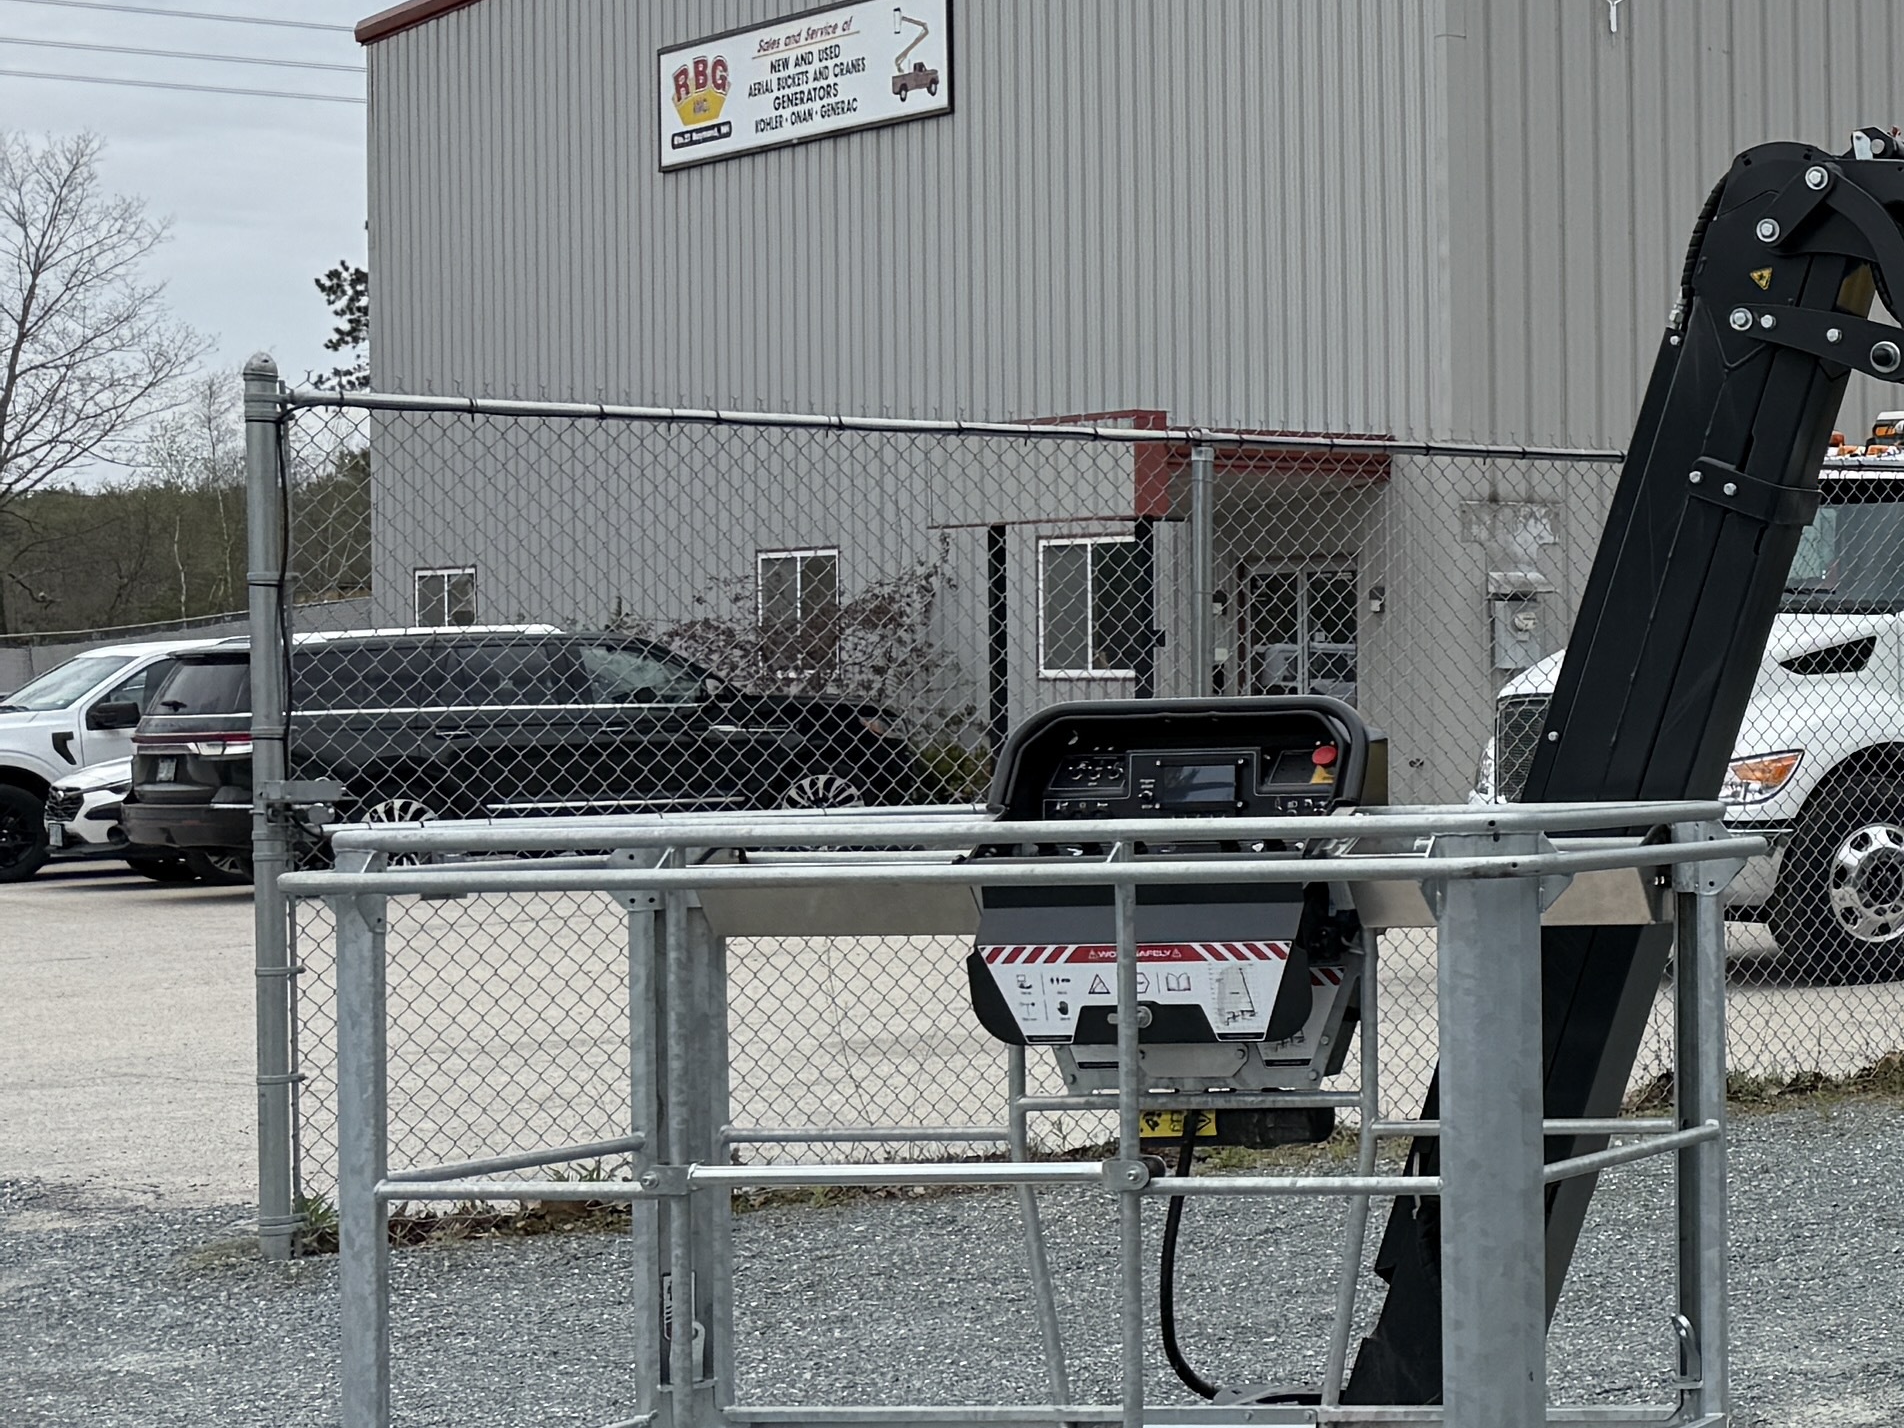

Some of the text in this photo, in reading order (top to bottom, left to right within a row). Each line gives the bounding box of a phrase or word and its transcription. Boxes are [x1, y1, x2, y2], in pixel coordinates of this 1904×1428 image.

[757, 16, 853, 53] Sales and Service of
[770, 44, 840, 74] NEW AND USED
[672, 55, 728, 104] RBG
[748, 57, 866, 98] AERIAL BUCKETS AND CRANES
[773, 83, 839, 111] GENERATORS
[755, 98, 858, 134] KOHLER ONAN GENERAC
